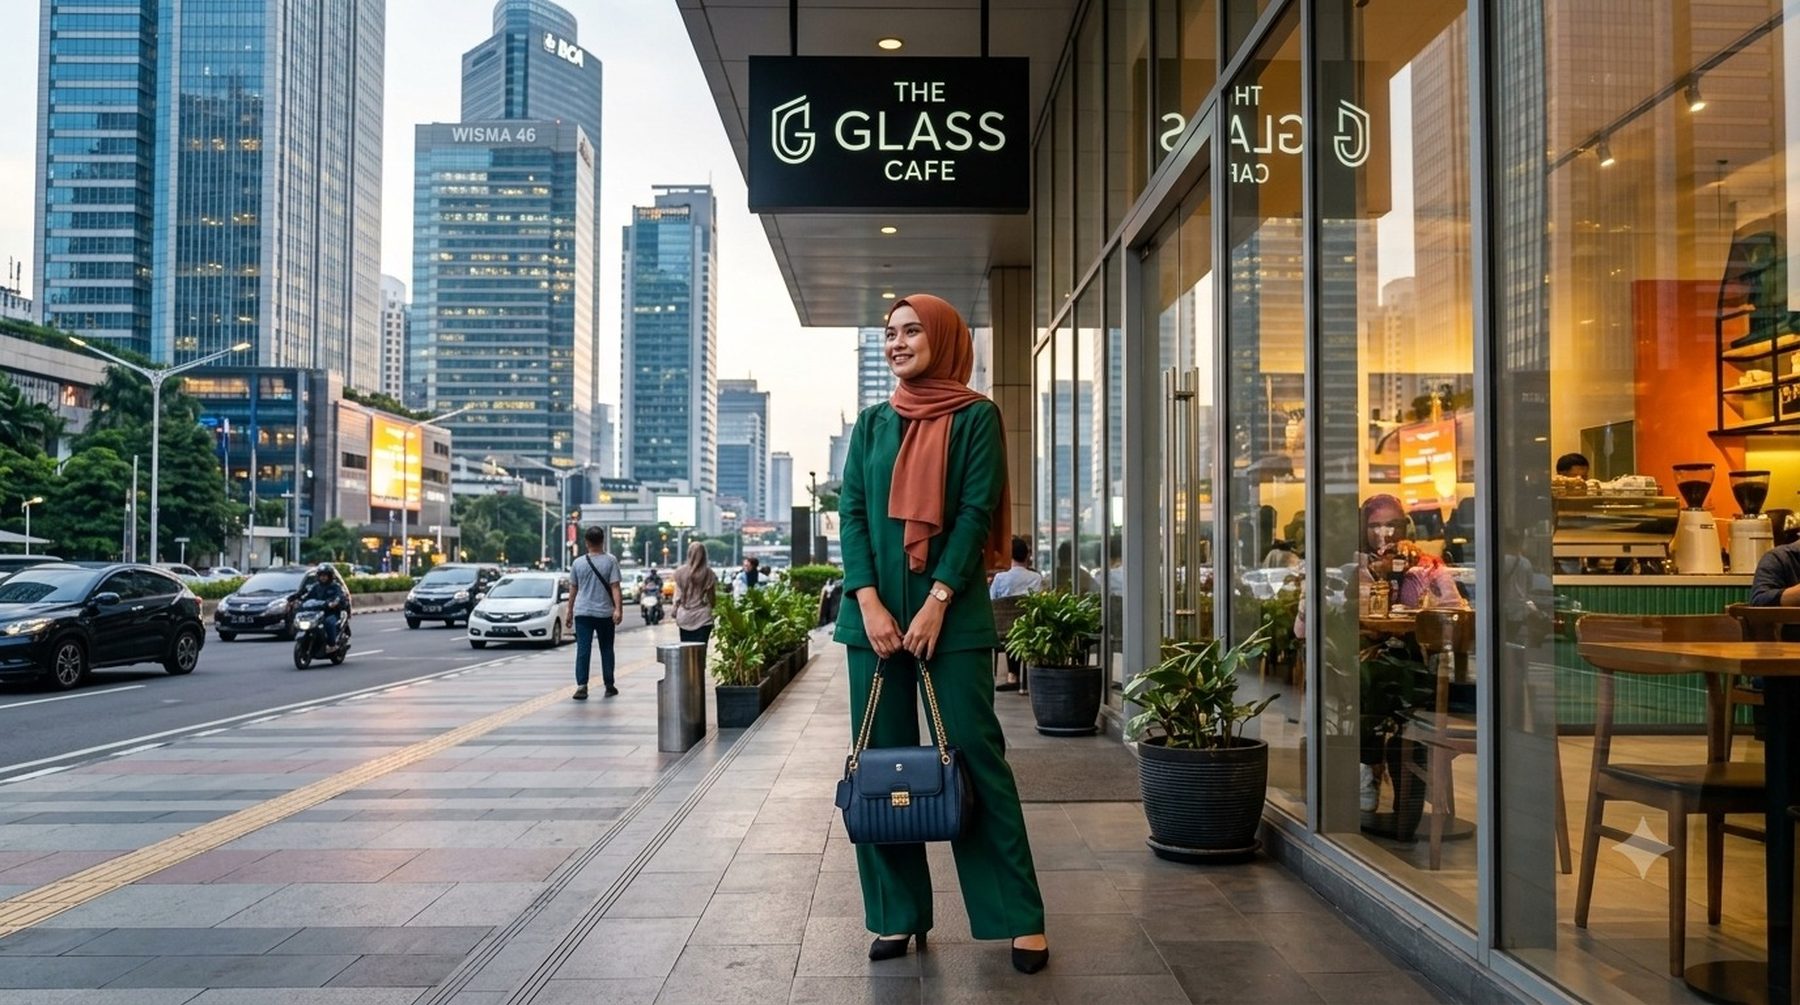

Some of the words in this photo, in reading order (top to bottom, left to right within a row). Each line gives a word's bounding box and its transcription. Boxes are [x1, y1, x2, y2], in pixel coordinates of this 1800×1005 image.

[557, 38, 584, 68] BCA
[893, 81, 946, 103] THE
[452, 127, 512, 143] WISMA
[516, 127, 537, 143] 46
[834, 110, 1007, 152] GLASS
[884, 159, 956, 182] CAFE
